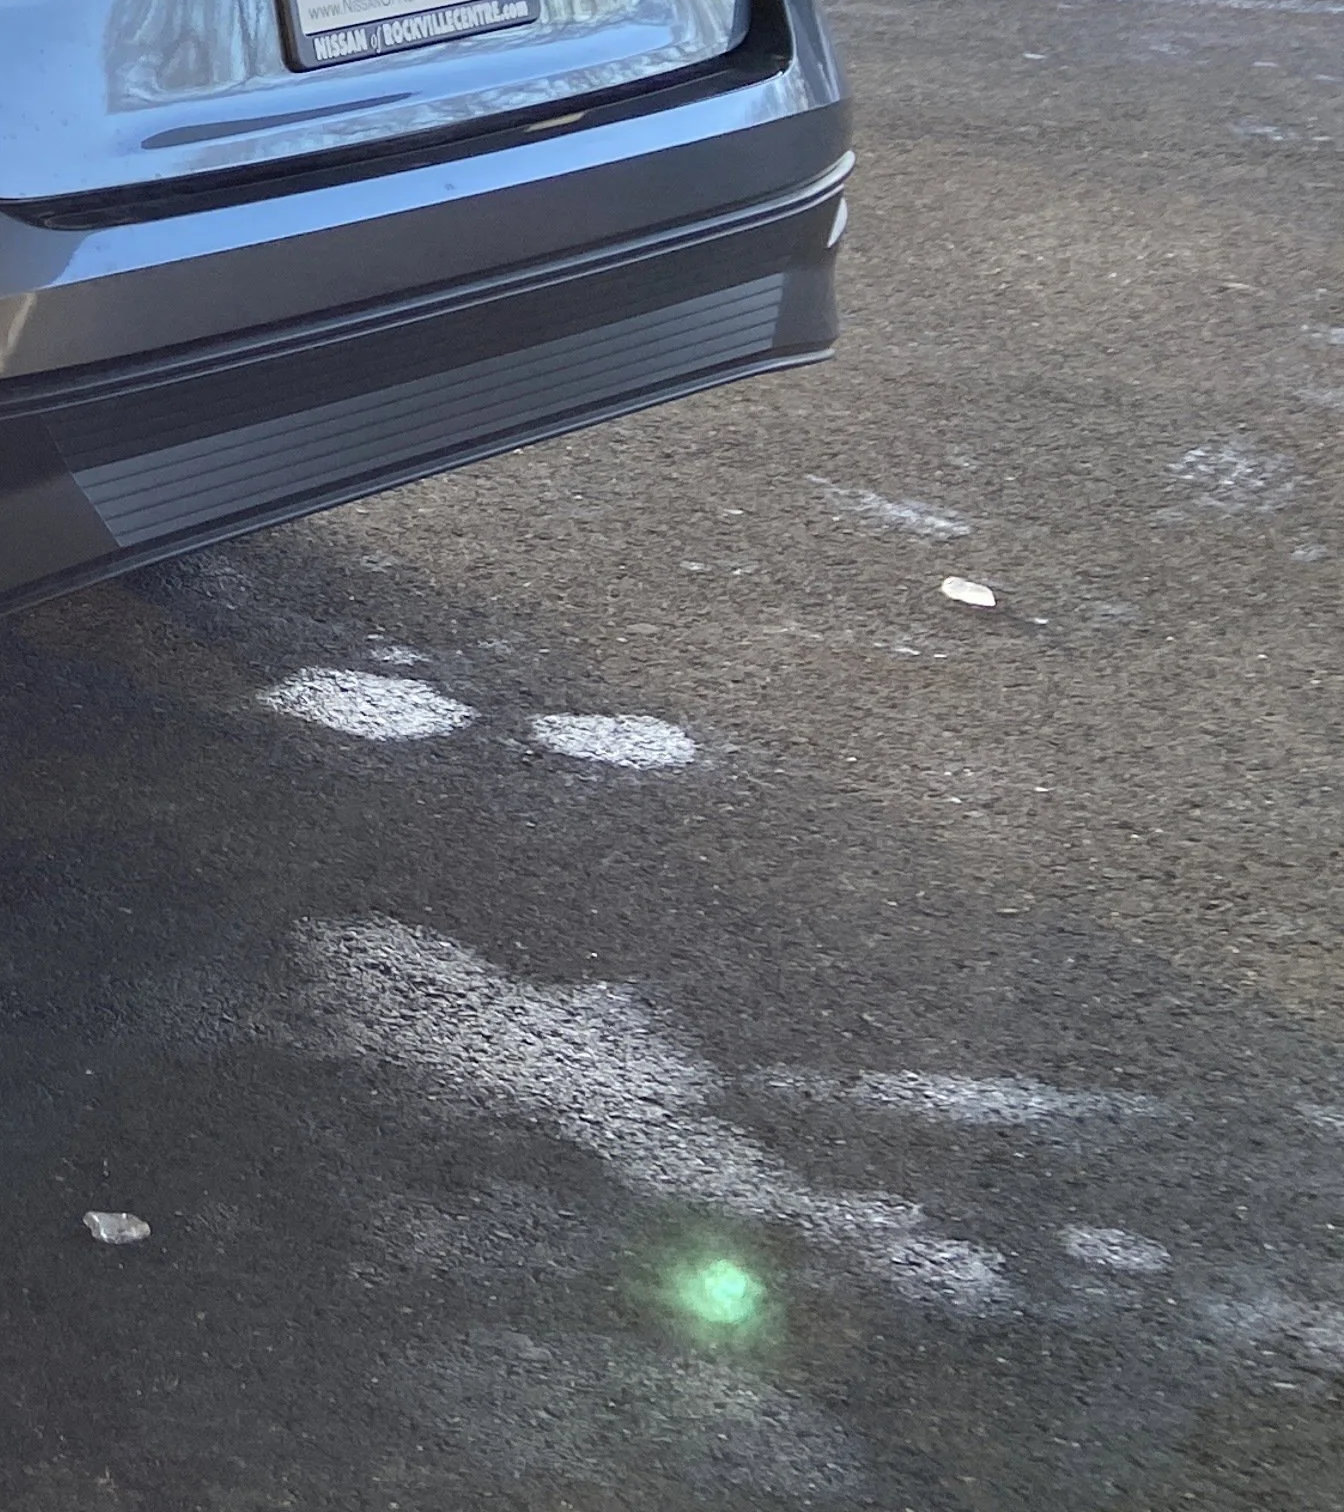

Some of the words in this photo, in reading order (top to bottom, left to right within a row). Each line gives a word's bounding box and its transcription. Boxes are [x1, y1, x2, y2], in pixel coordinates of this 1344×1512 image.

[314, 29, 368, 61] NISSAN
[370, 26, 382, 54] of
[382, 0, 529, 46] ROCKVILLECENTRE.com
